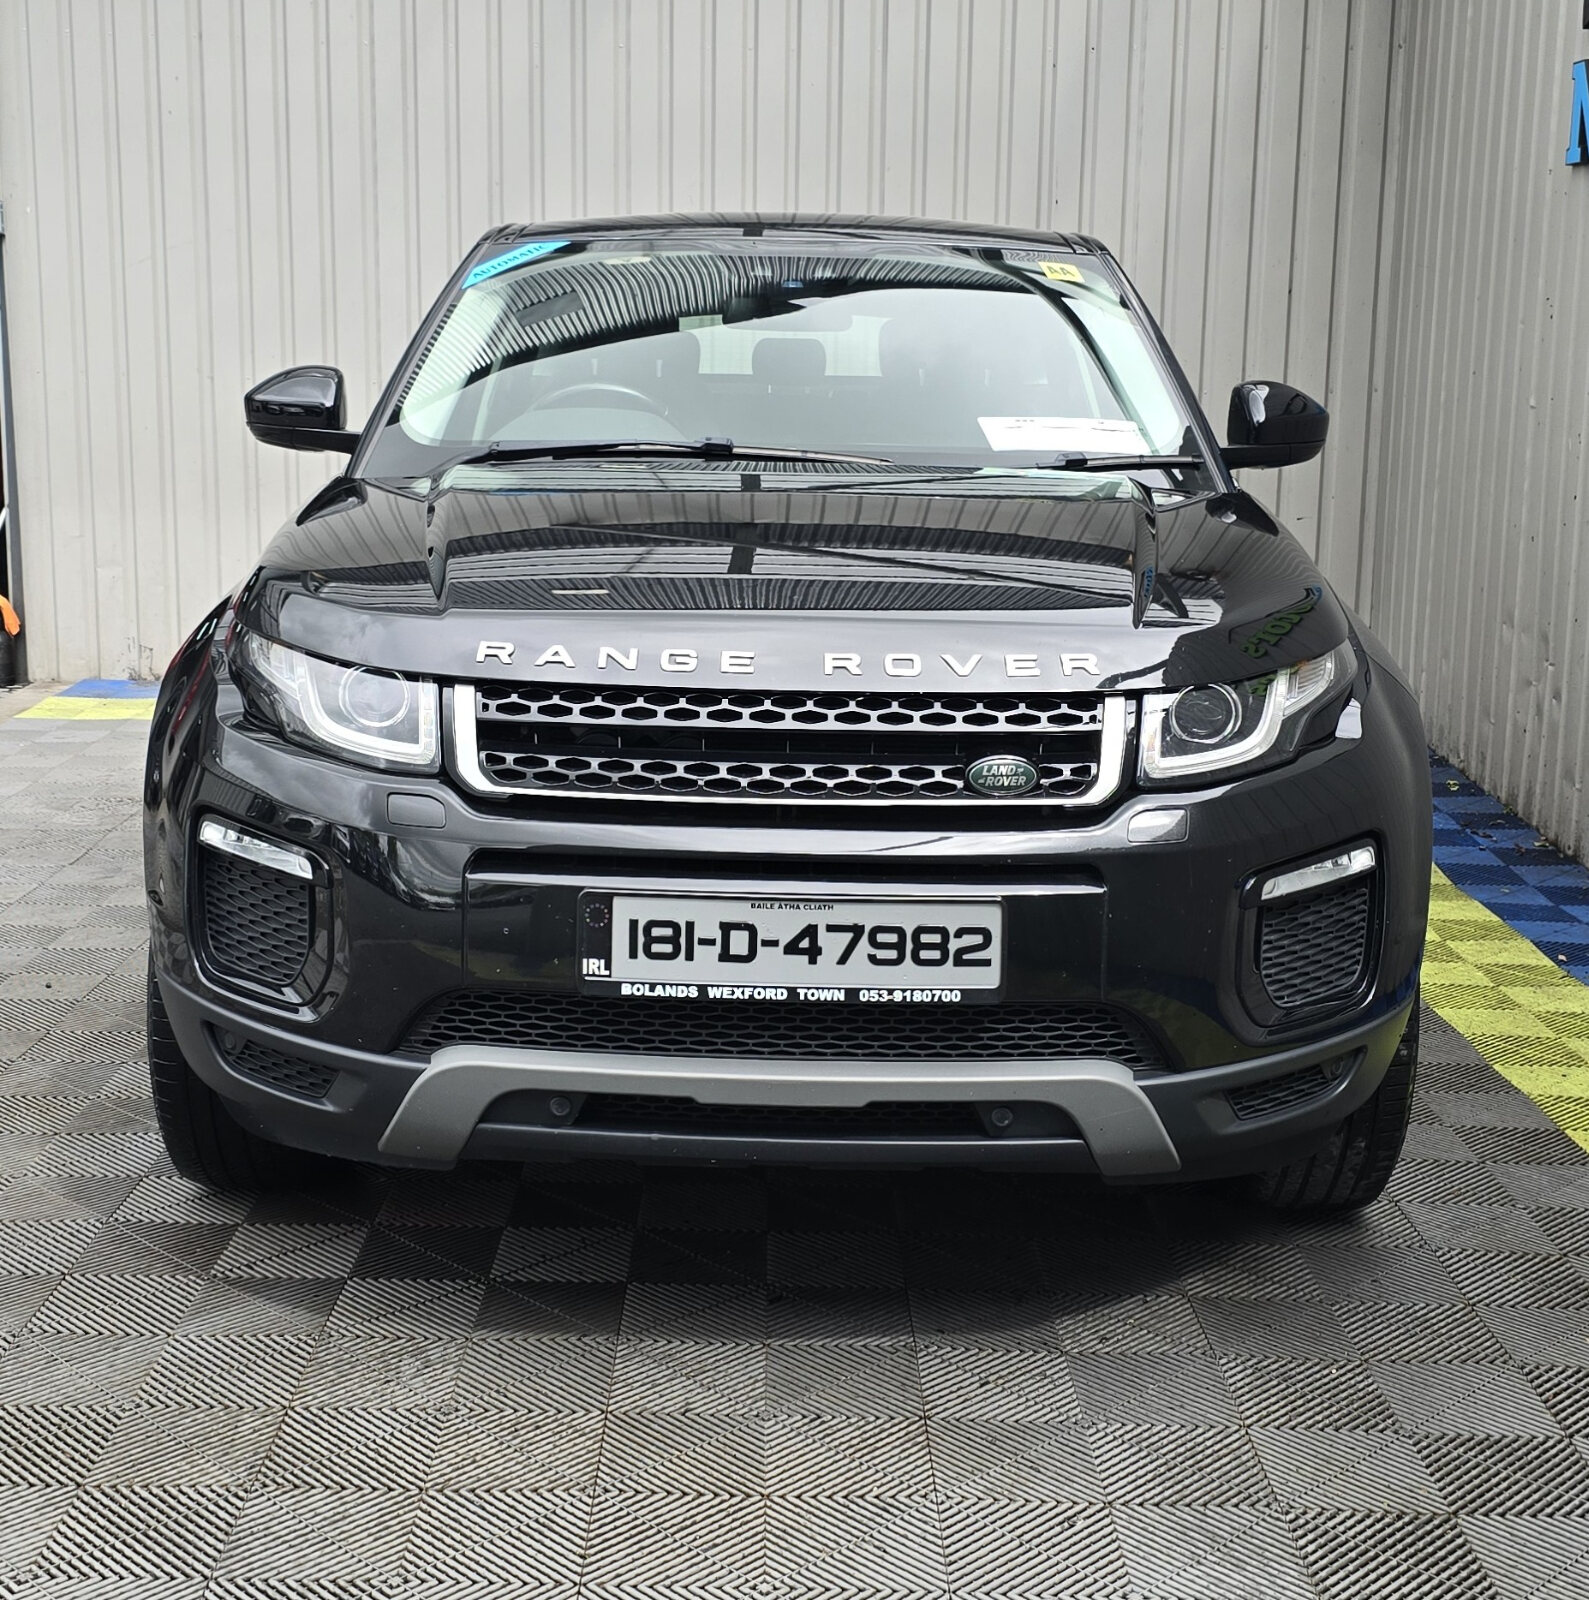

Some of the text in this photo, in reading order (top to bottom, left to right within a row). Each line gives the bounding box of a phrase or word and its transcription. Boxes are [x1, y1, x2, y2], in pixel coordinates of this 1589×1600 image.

[473, 244, 547, 279] AUTOMATIC
[1046, 265, 1076, 277] AA
[475, 640, 1102, 679] RANGE ROVER
[982, 765, 1016, 776] LAND
[985, 775, 1027, 787] ROVER
[628, 918, 993, 967] 181-D-47982
[582, 958, 610, 976] IRL
[620, 982, 961, 1003] BOLANDS WEXFORD TOWN 053-9180700
